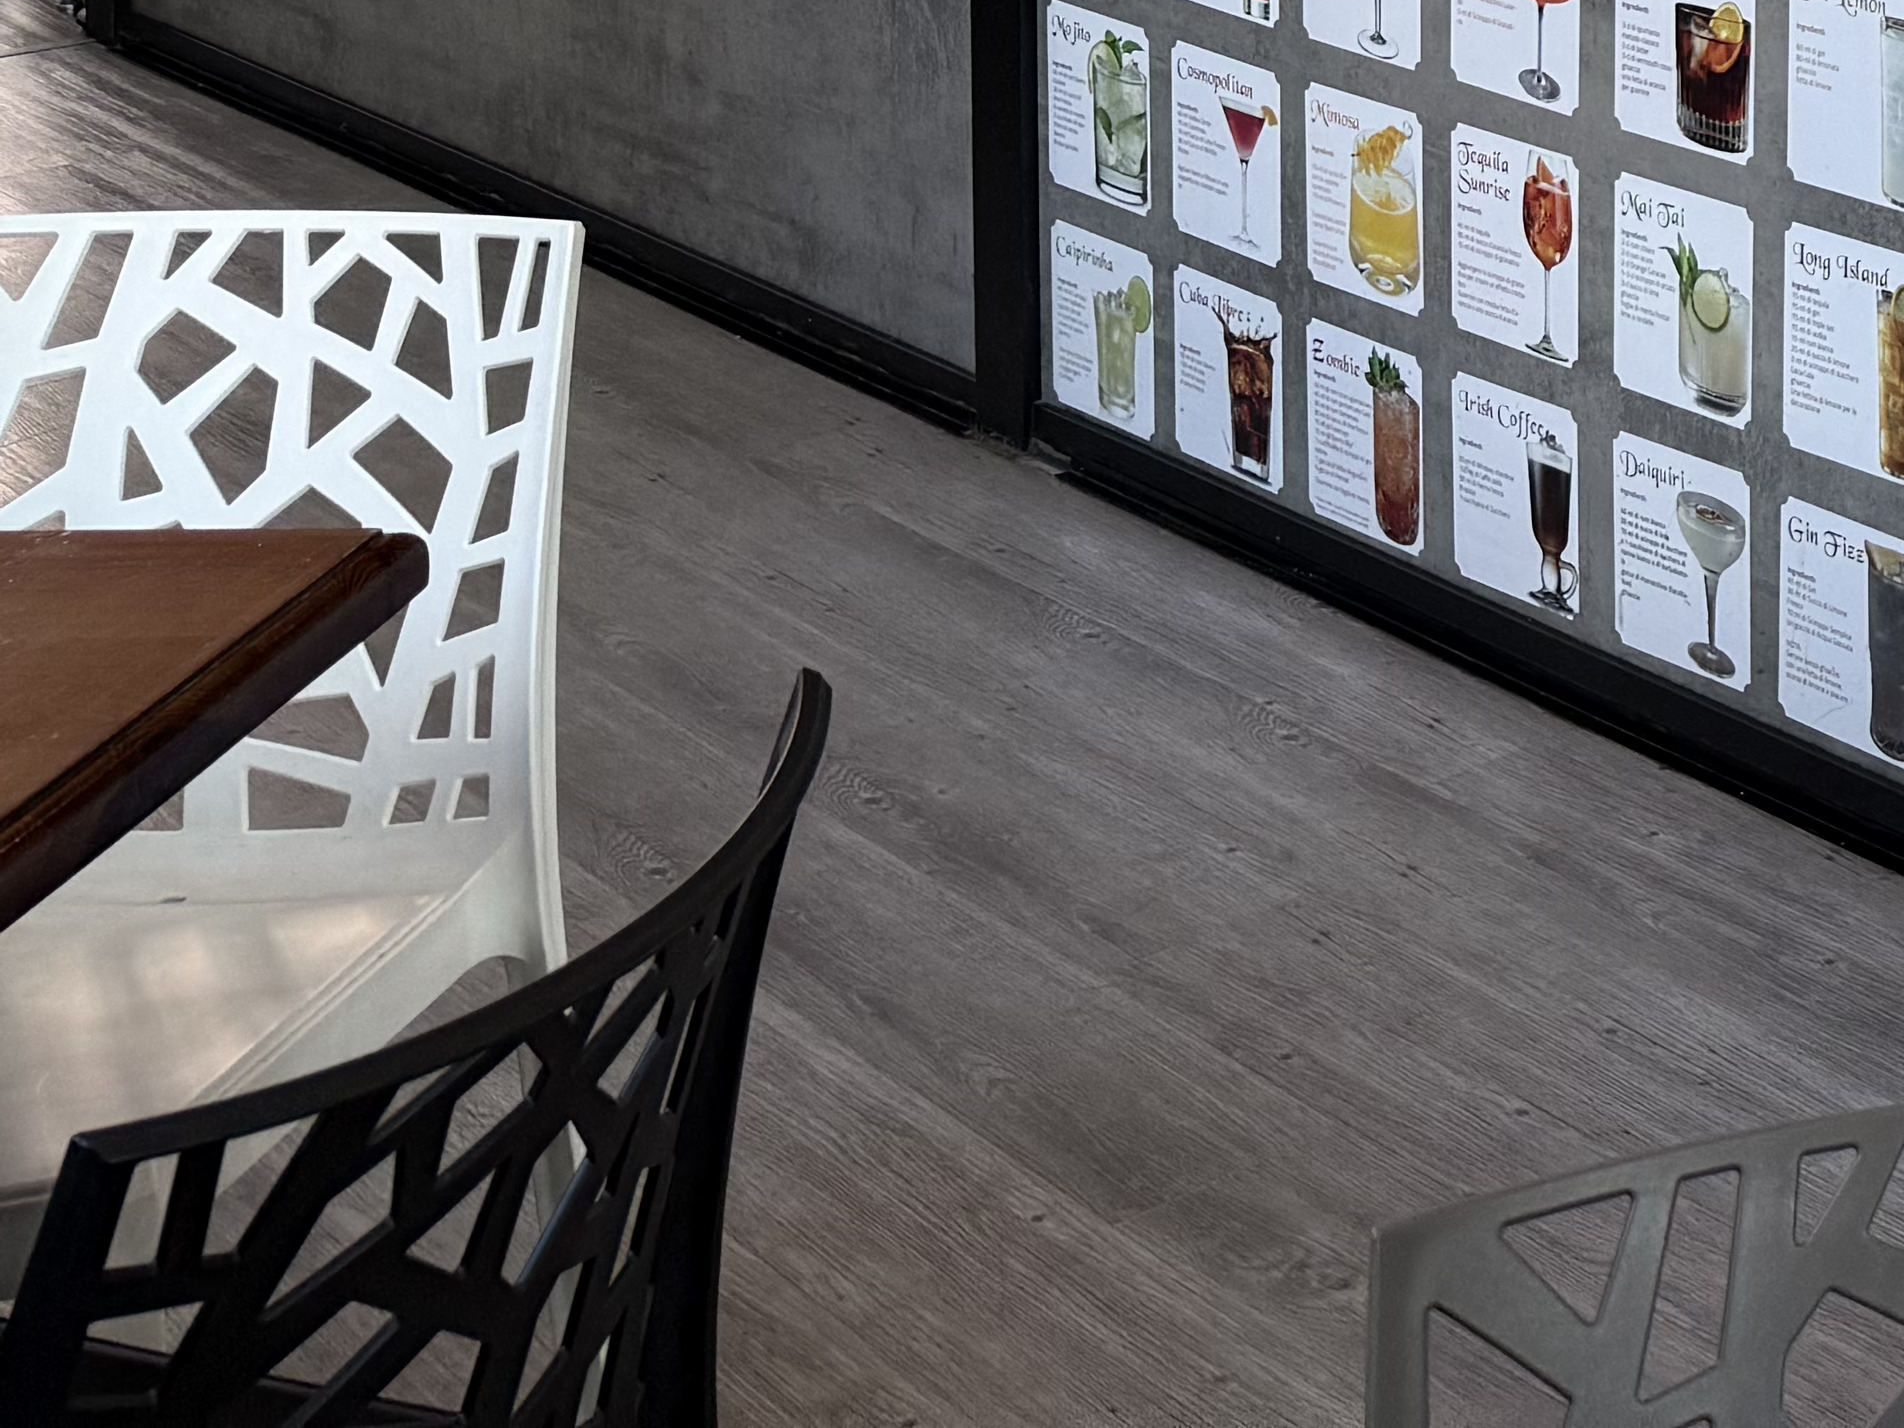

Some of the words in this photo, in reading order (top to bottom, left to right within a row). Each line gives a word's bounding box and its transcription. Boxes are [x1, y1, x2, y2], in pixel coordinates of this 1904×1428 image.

[1051, 15, 1092, 45] Mojito
[1177, 57, 1254, 99] Cosmopolitan
[1310, 98, 1360, 132] Mimosa
[1457, 141, 1511, 174] Tequila
[1457, 169, 1511, 202] Sunrise
[1621, 190, 1655, 219] Mai
[1658, 195, 1684, 228] Tai
[1055, 233, 1114, 273] Caipirinha
[1793, 242, 1831, 273] Long
[1836, 254, 1891, 288] Island
[1311, 340, 1361, 378] Zombie
[1457, 387, 1494, 418] Irish
[1619, 449, 1686, 488] Daiquiri
[1787, 517, 1819, 546] Gin
[1824, 528, 1865, 563] Fizz
